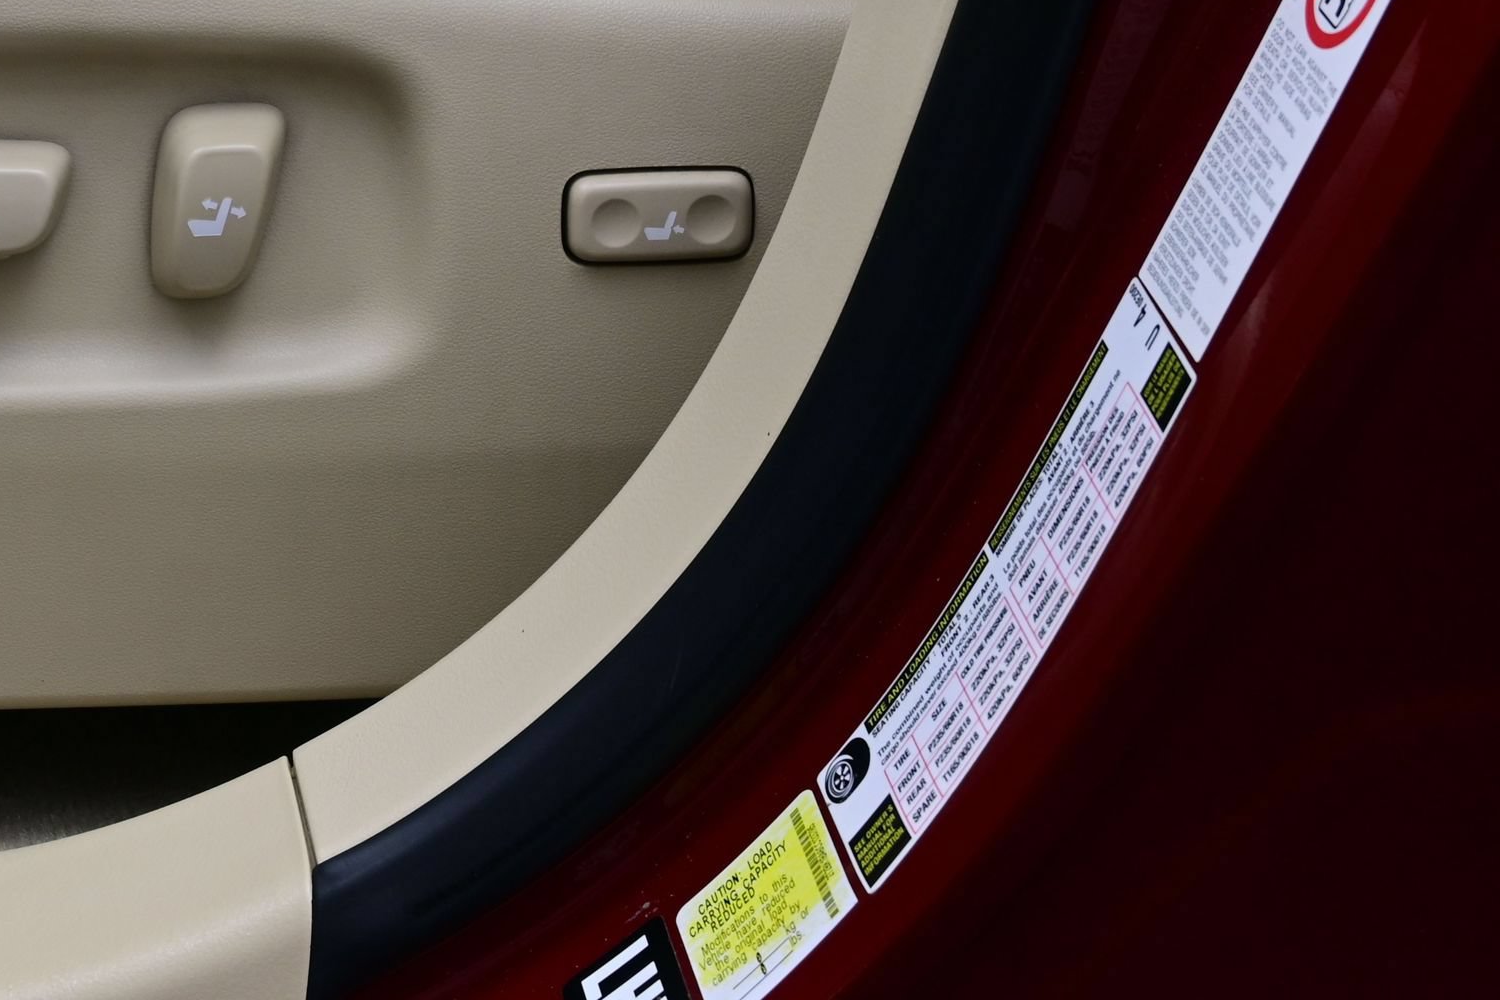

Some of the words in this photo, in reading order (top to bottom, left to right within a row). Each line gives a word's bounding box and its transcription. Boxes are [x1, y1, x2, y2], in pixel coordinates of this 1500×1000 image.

[1042, 448, 1058, 477] TOTAL
[1046, 454, 1063, 485] AVANT
[1018, 557, 1036, 589] PNEU
[1046, 474, 1084, 540] DIMENSIONS
[940, 624, 962, 657] FRONT
[971, 580, 990, 609] REAR
[1026, 567, 1048, 604] AVANT
[1031, 576, 1059, 623] ARRIÈRE
[1044, 586, 1069, 628] SECOURS
[867, 699, 887, 727] TIRE
[886, 676, 905, 703] AND
[904, 630, 938, 680] LOADING
[937, 553, 987, 632] INFORMATION
[871, 698, 900, 739] SEATING
[899, 657, 931, 702] CAPACITY
[936, 618, 956, 649] TOTAL
[877, 738, 891, 759] The
[890, 693, 924, 740] combined
[880, 740, 900, 768] cargo
[898, 711, 920, 743] should
[919, 689, 937, 715] never
[893, 746, 910, 772] TIRE
[930, 696, 947, 722] SIZE
[897, 758, 921, 794] FRONT
[906, 775, 927, 807] REAR
[912, 787, 937, 825] SPARE
[697, 869, 743, 916] CAUTION:
[746, 839, 773, 870] LOAD
[856, 827, 882, 862] MANUAL
[864, 824, 904, 877] INFORMATION
[688, 887, 739, 939] CARRYING
[741, 839, 788, 890] CAPACITY
[700, 902, 755, 958] Modifications
[771, 871, 788, 892] this
[709, 885, 756, 933] REDUCED
[699, 938, 731, 973] Vehicle
[734, 914, 758, 940] have
[760, 877, 796, 916] reduced
[711, 950, 748, 987] carrying
[751, 914, 786, 951] capacity
[714, 952, 730, 972] the
[734, 919, 766, 956] original
[768, 897, 788, 922] load
